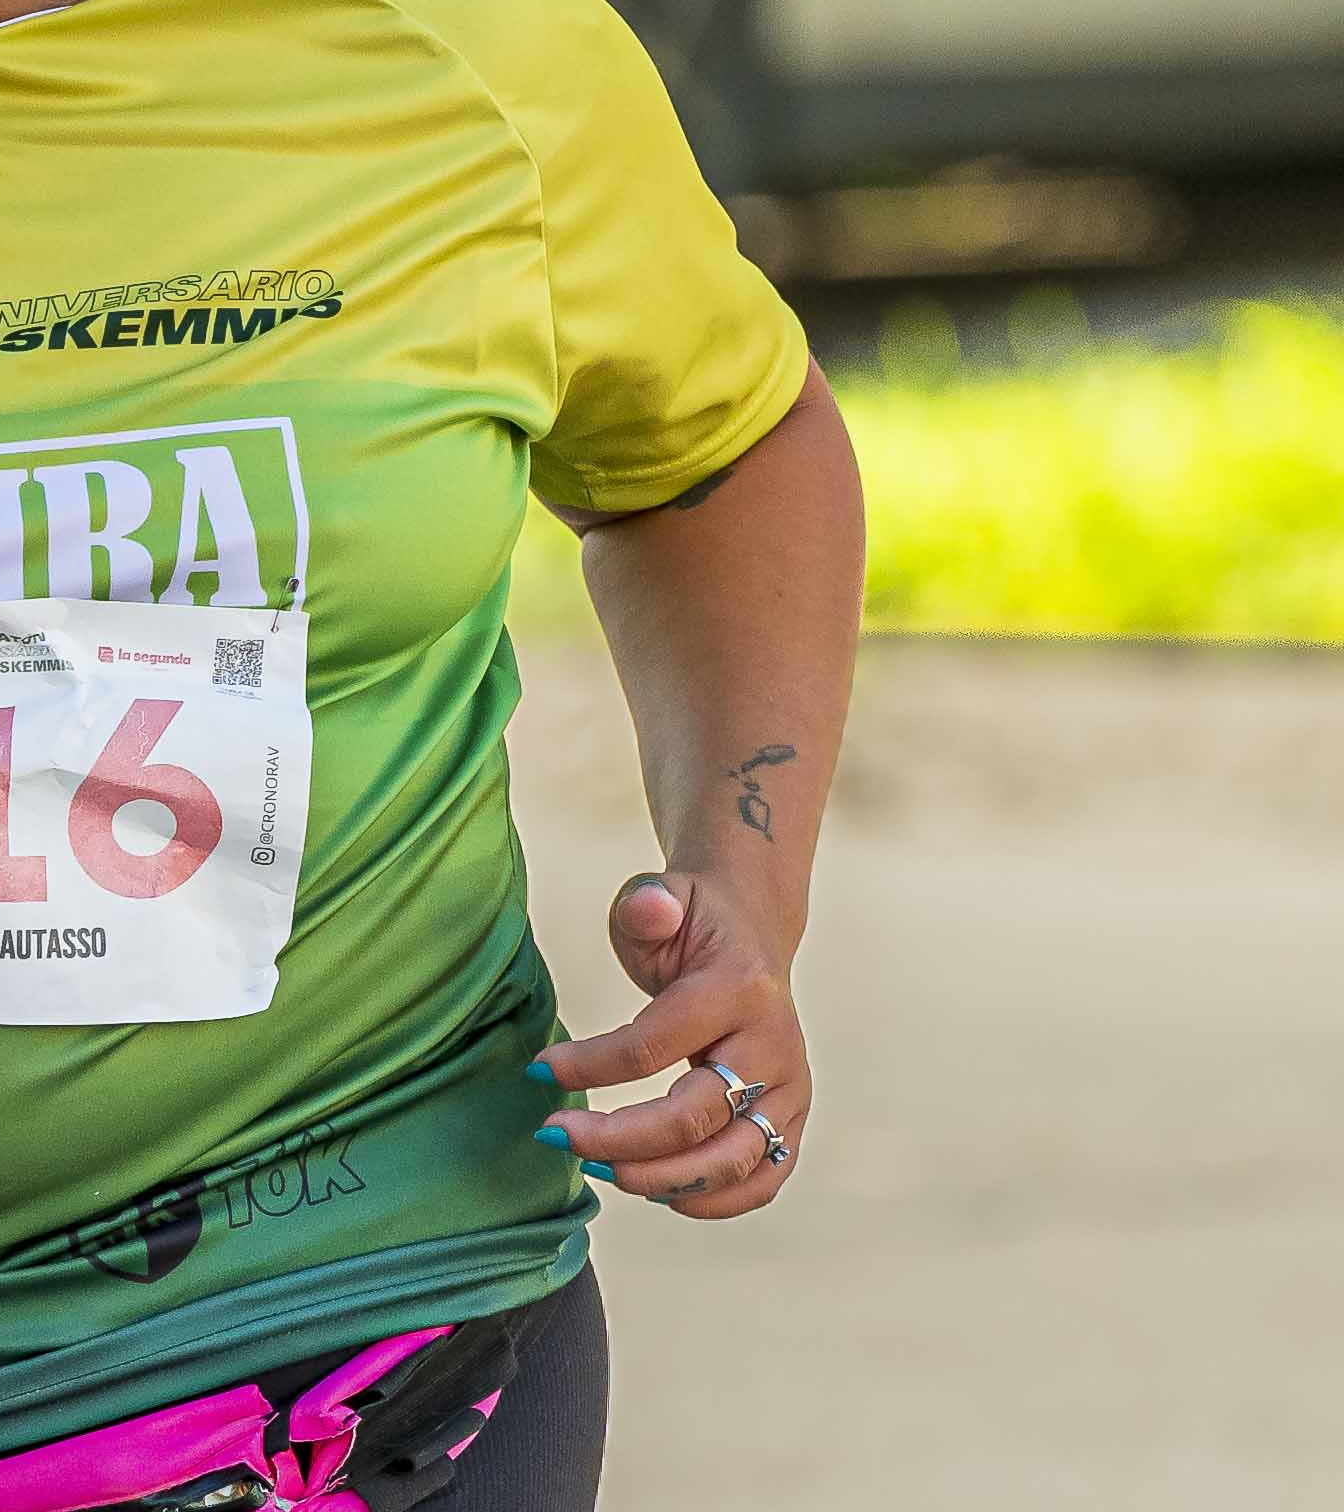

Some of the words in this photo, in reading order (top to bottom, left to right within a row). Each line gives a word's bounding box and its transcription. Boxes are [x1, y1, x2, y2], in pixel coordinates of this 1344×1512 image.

[118, 648, 131, 661] la
[134, 652, 192, 665] segunda
[260, 746, 280, 845] @CRONORAV
